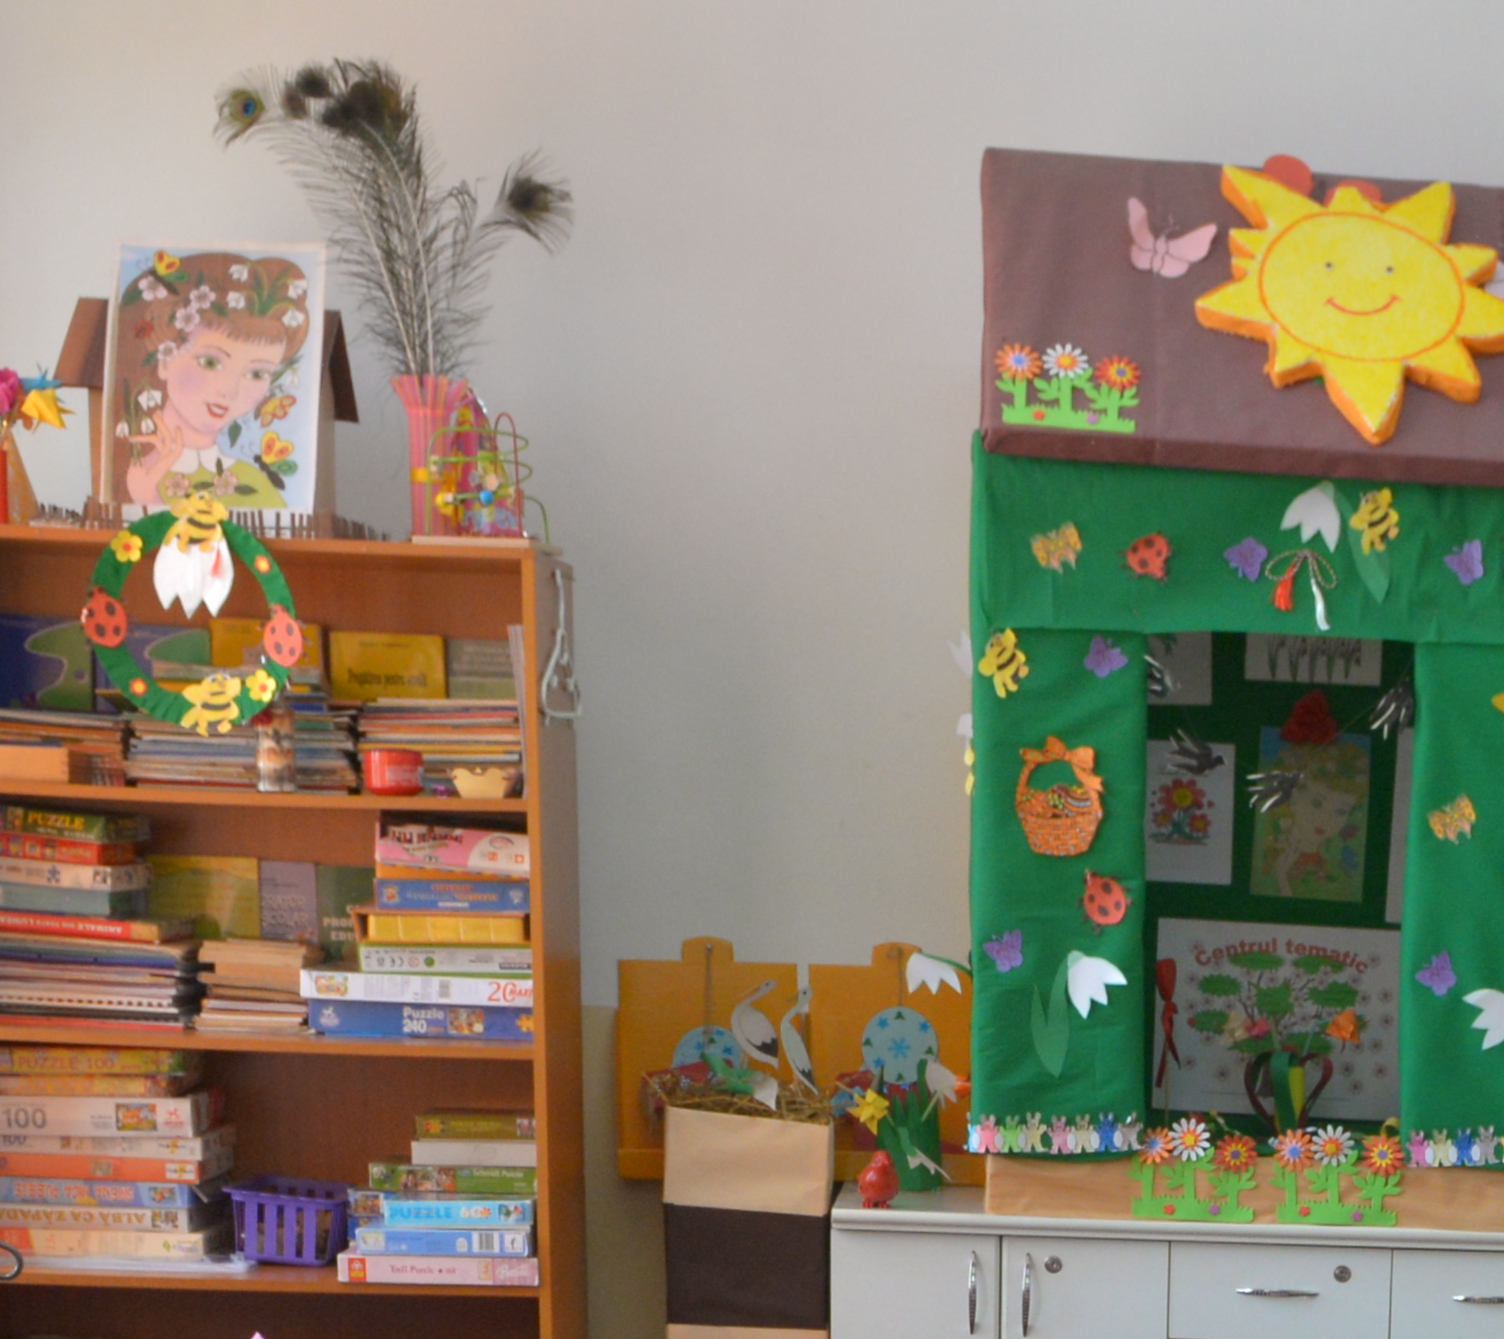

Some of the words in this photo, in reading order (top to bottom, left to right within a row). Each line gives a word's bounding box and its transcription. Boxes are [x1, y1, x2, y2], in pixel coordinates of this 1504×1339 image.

[27, 811, 84, 831] PUZZLE
[1195, 938, 1279, 967] Centrul
[1285, 938, 1369, 975] tematic
[402, 1006, 444, 1021] Puzzle
[402, 1018, 427, 1033] 240
[1, 1107, 47, 1130] 100
[73, 1208, 95, 1223] CA
[389, 1206, 452, 1220] PUZZLE
